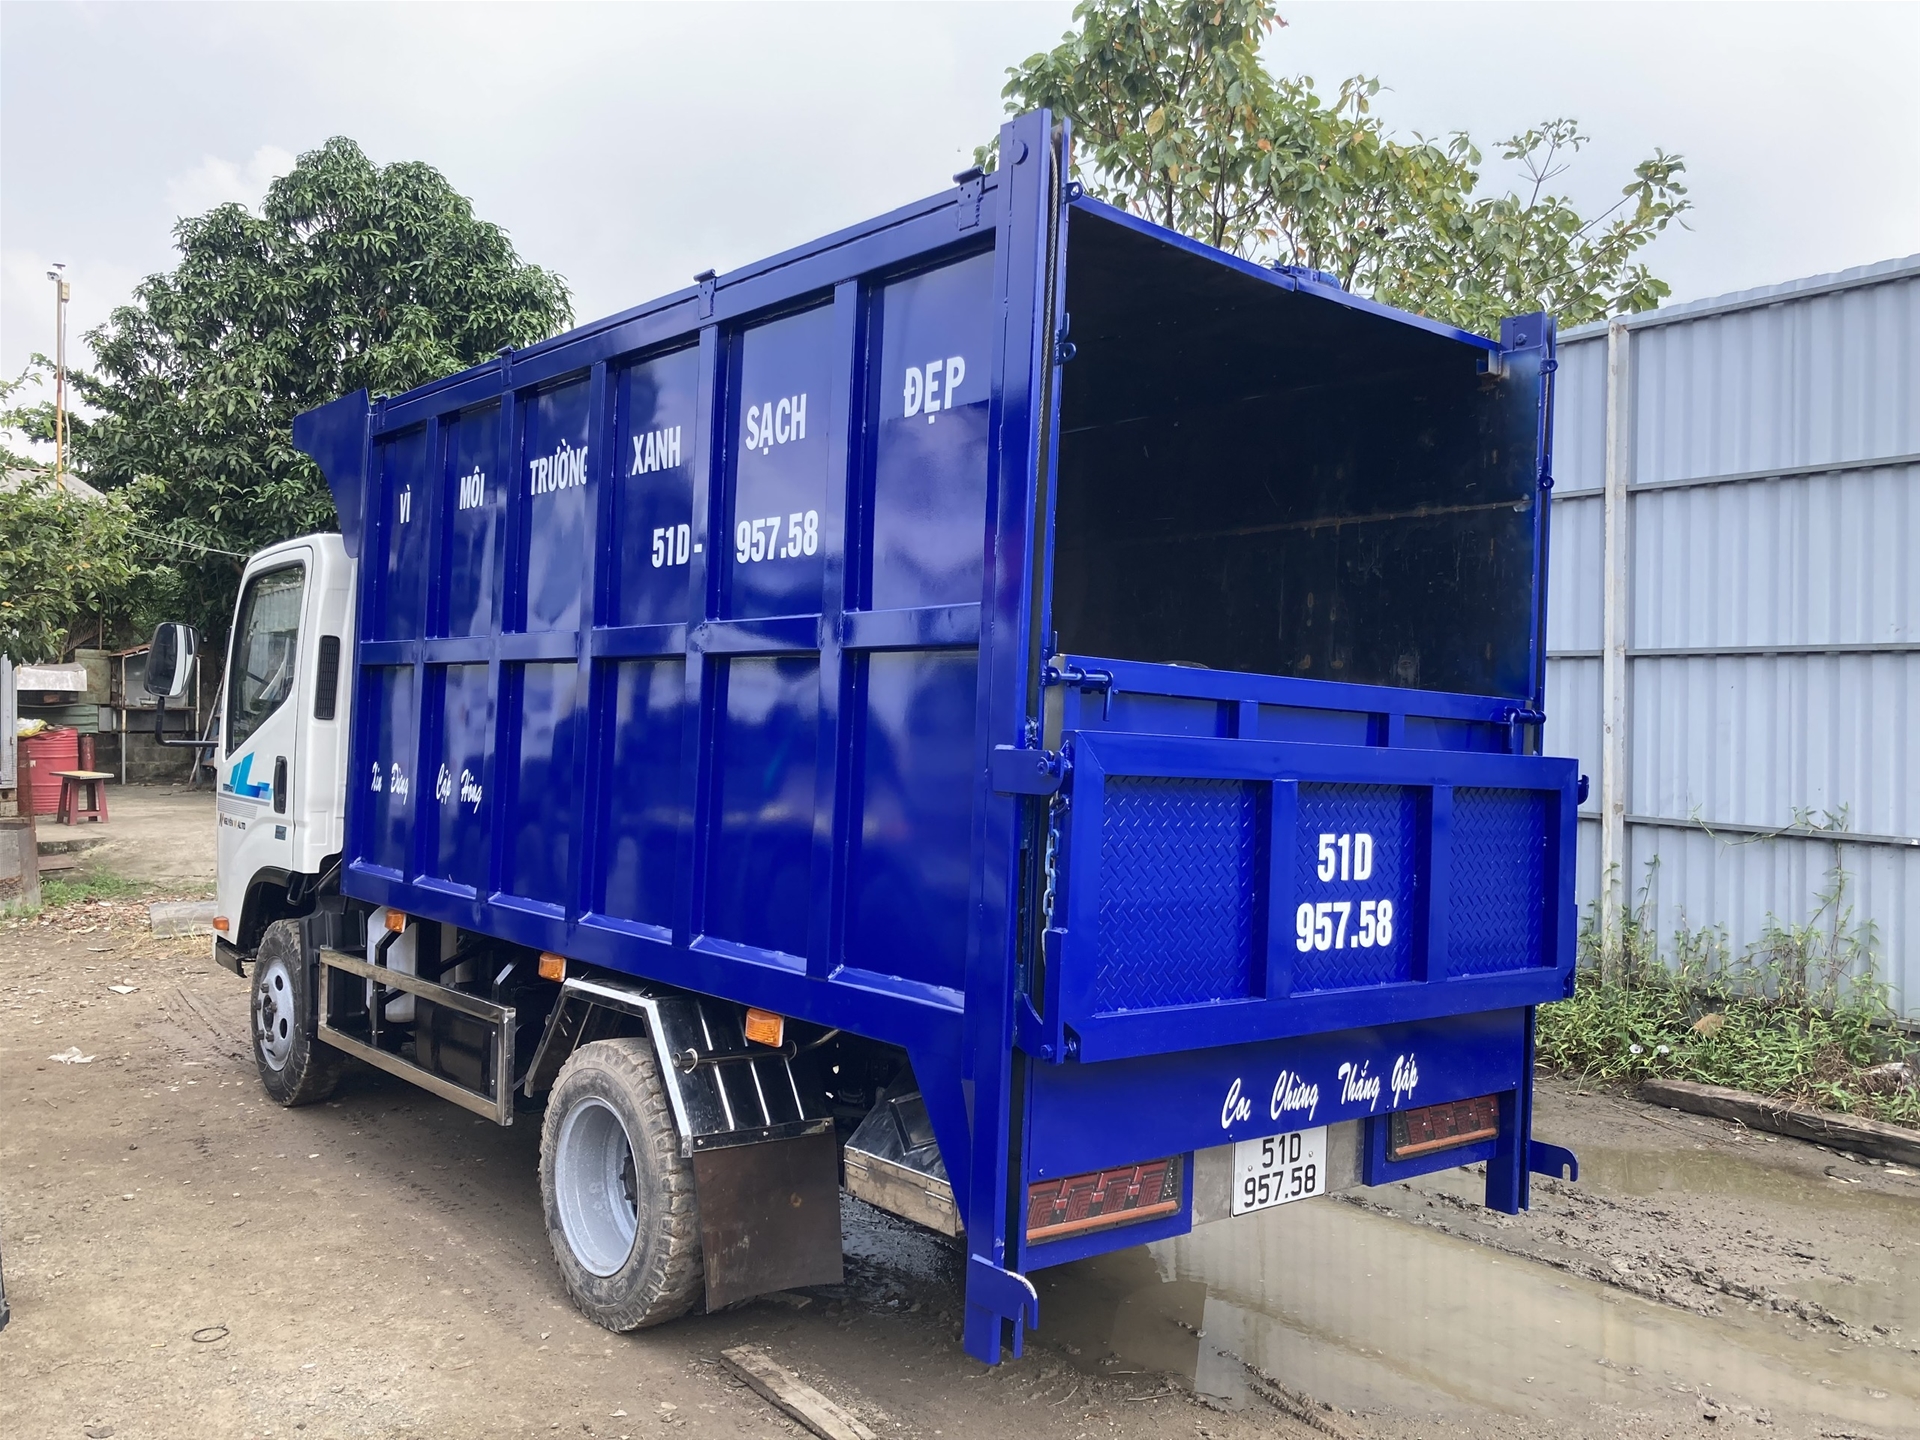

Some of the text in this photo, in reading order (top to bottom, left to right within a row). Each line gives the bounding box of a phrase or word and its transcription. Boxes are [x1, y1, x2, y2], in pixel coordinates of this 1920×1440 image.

[399, 484, 411, 524] VÌ
[459, 465, 485, 510] MÔI
[631, 425, 681, 476] XANH
[744, 393, 807, 456] SẠCH
[903, 355, 966, 425] ĐẸP
[736, 509, 819, 564] 957.58
[1317, 833, 1372, 882] 51D
[1296, 899, 1393, 952] 957.58
[1262, 1132, 1302, 1168] 51D
[1243, 1163, 1316, 1208] 957.58
